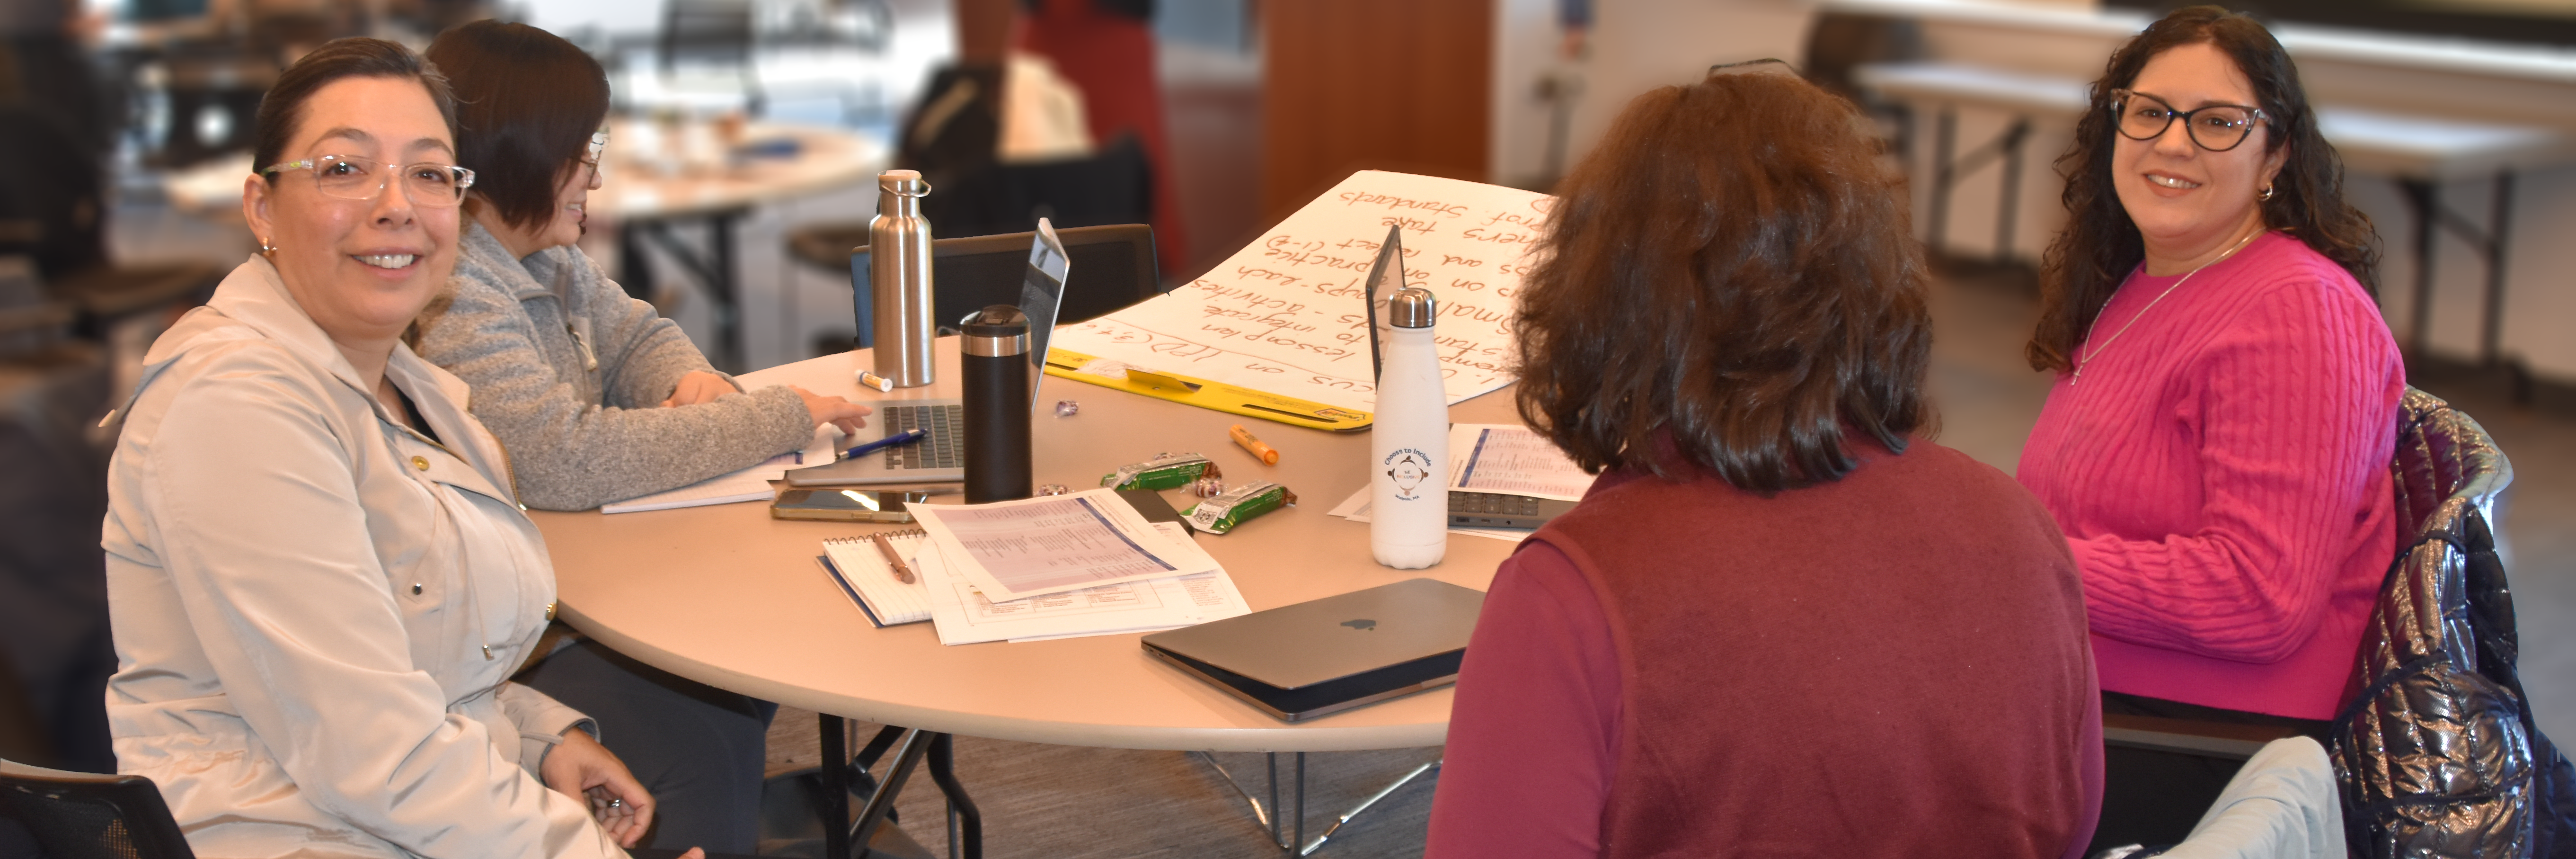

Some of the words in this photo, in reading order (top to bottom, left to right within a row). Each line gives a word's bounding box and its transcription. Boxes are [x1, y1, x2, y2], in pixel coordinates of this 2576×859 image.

[1339, 191, 1468, 218] Standards
[1381, 216, 1438, 235] take
[1265, 248, 1376, 272] practice
[1441, 254, 1482, 267] and
[1452, 278, 1486, 292] on
[1190, 279, 1305, 313] activities
[1204, 305, 1316, 332] integrate
[1266, 336, 1355, 362] lesson
[1336, 333, 1365, 346] to
[1245, 363, 1285, 374] on
[1307, 376, 1375, 393] cus
[1385, 449, 1403, 465] Choose
[1413, 448, 1432, 467] Include
